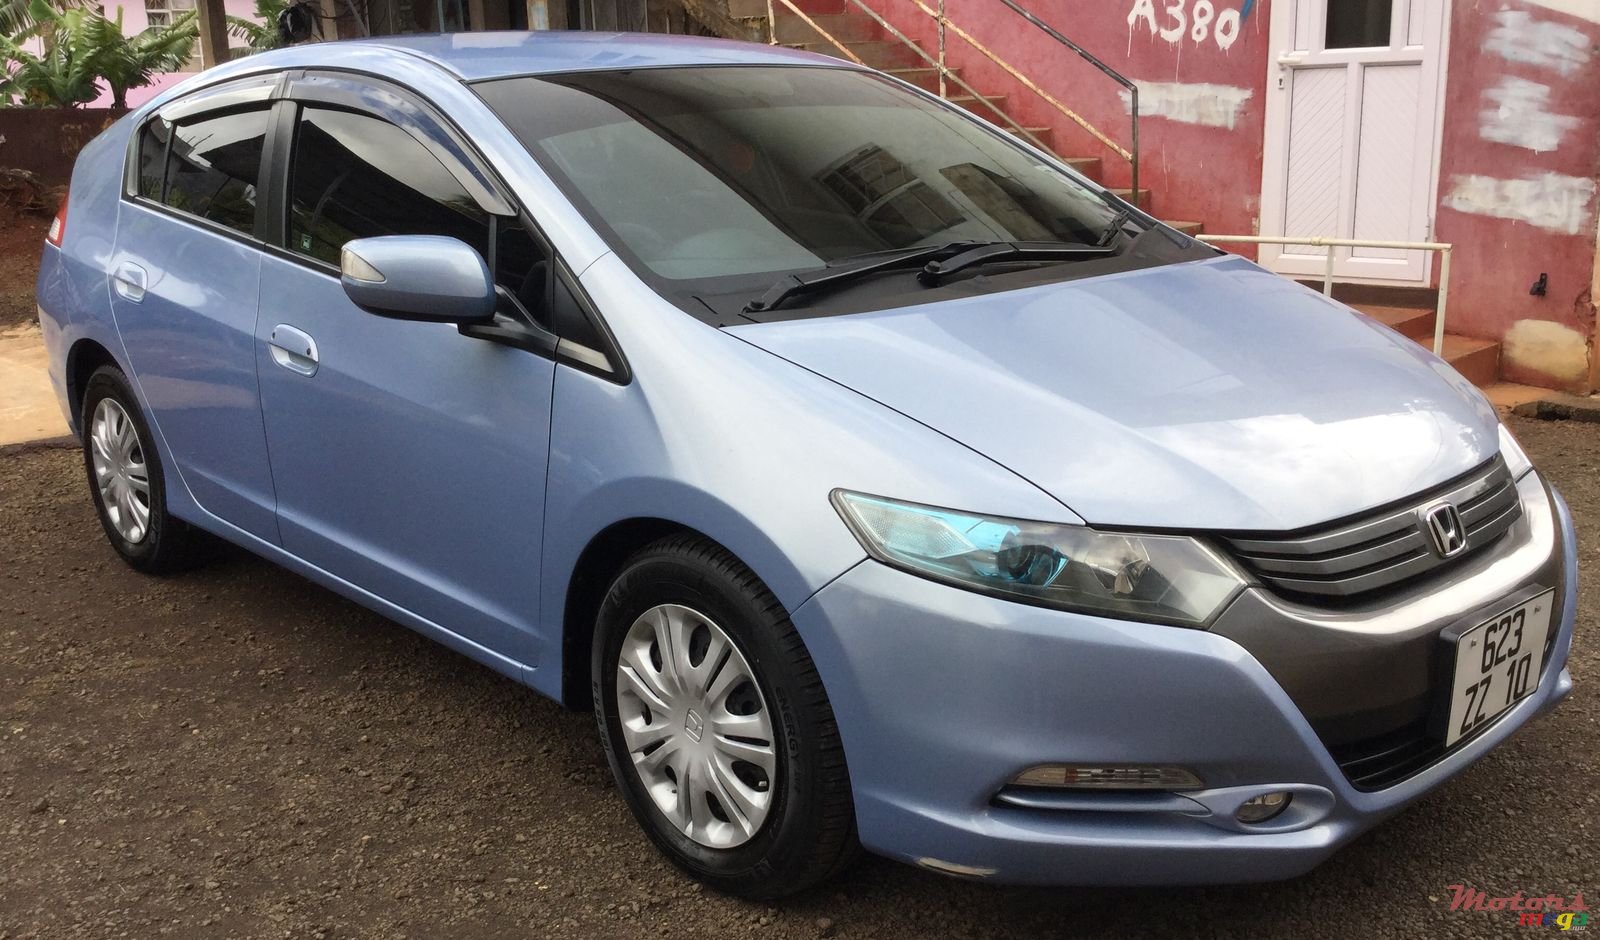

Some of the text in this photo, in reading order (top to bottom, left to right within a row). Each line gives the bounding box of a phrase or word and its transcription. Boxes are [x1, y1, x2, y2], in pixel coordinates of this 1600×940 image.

[1127, 0, 1240, 51] A380
[1481, 608, 1526, 674] 623
[1460, 652, 1532, 736] ZZ 10
